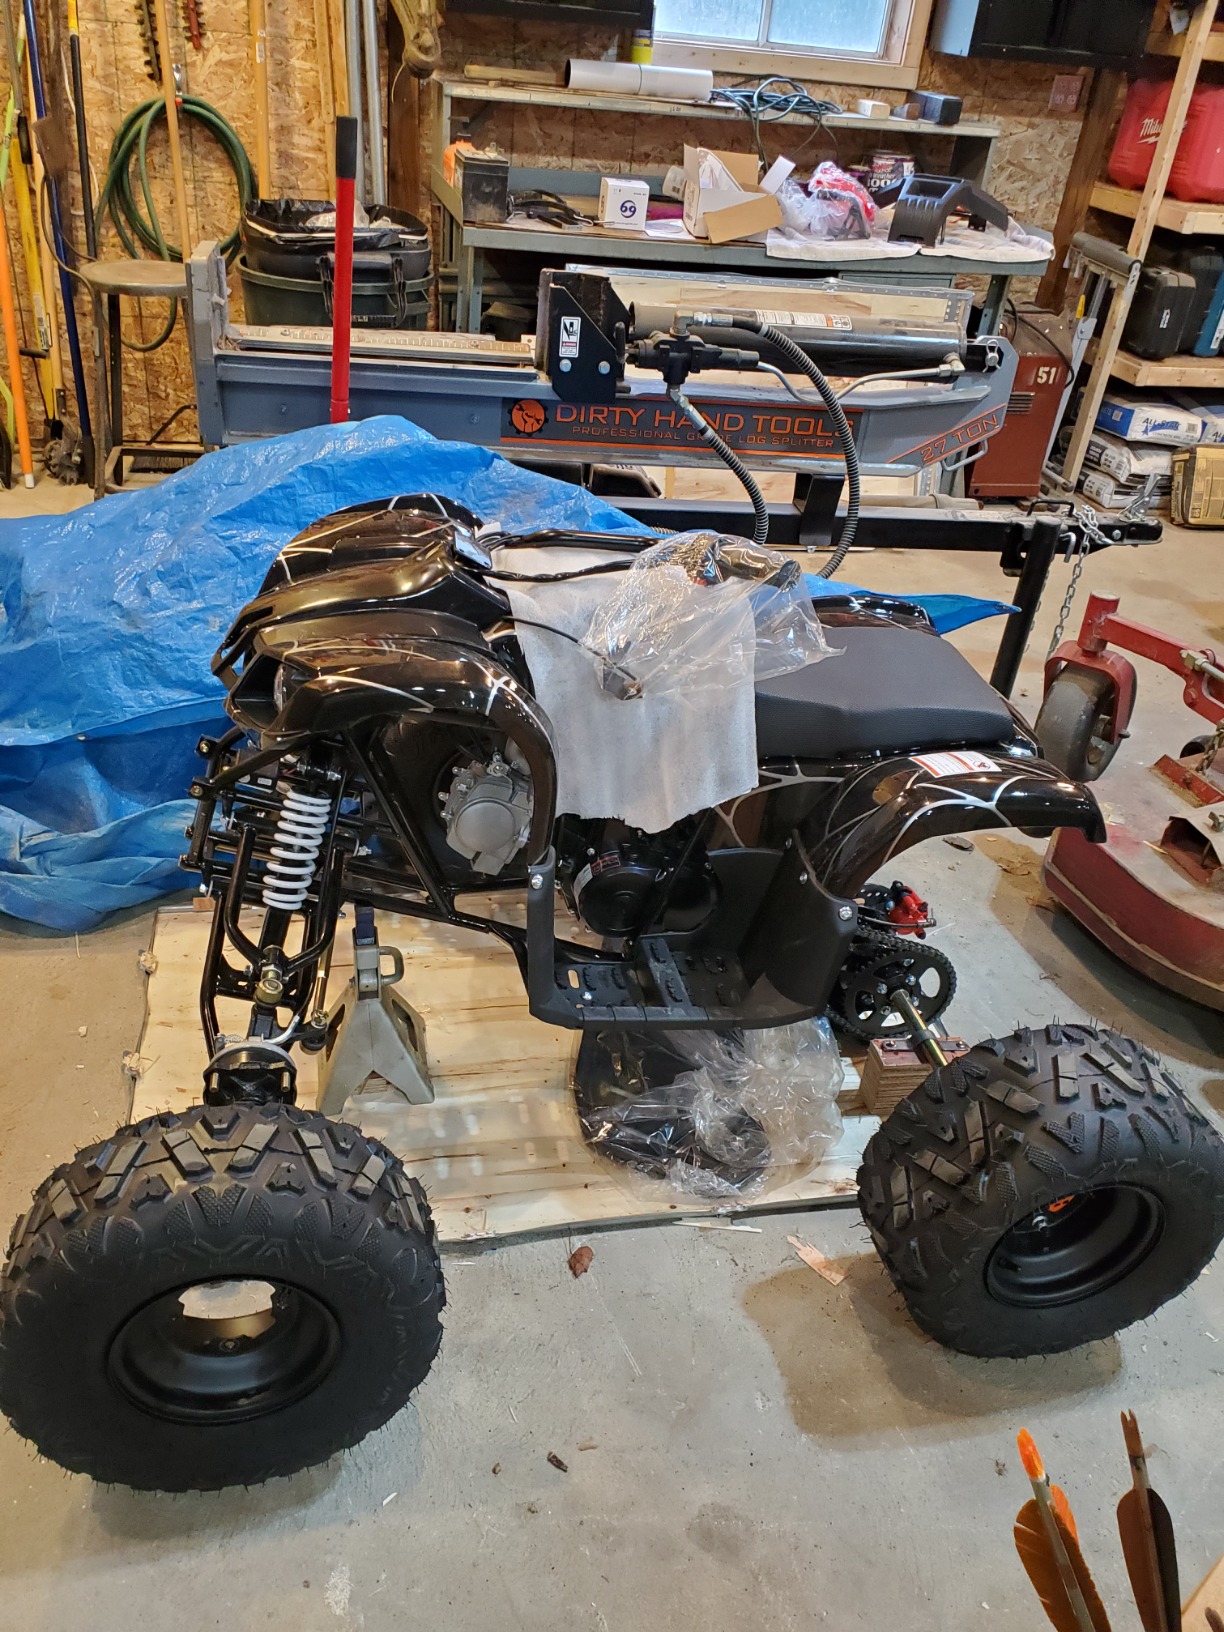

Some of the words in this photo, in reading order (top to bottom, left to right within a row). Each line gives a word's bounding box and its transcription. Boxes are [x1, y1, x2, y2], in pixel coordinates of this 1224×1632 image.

[1037, 366, 1057, 384] 51
[556, 404, 646, 426] DIRTY
[572, 426, 680, 440] PROFESSIONAL
[687, 432, 732, 443] GRDE
[739, 435, 766, 444] LOG
[772, 436, 834, 448] SPLITTER
[921, 438, 947, 462] 27
[952, 414, 999, 443] TON
